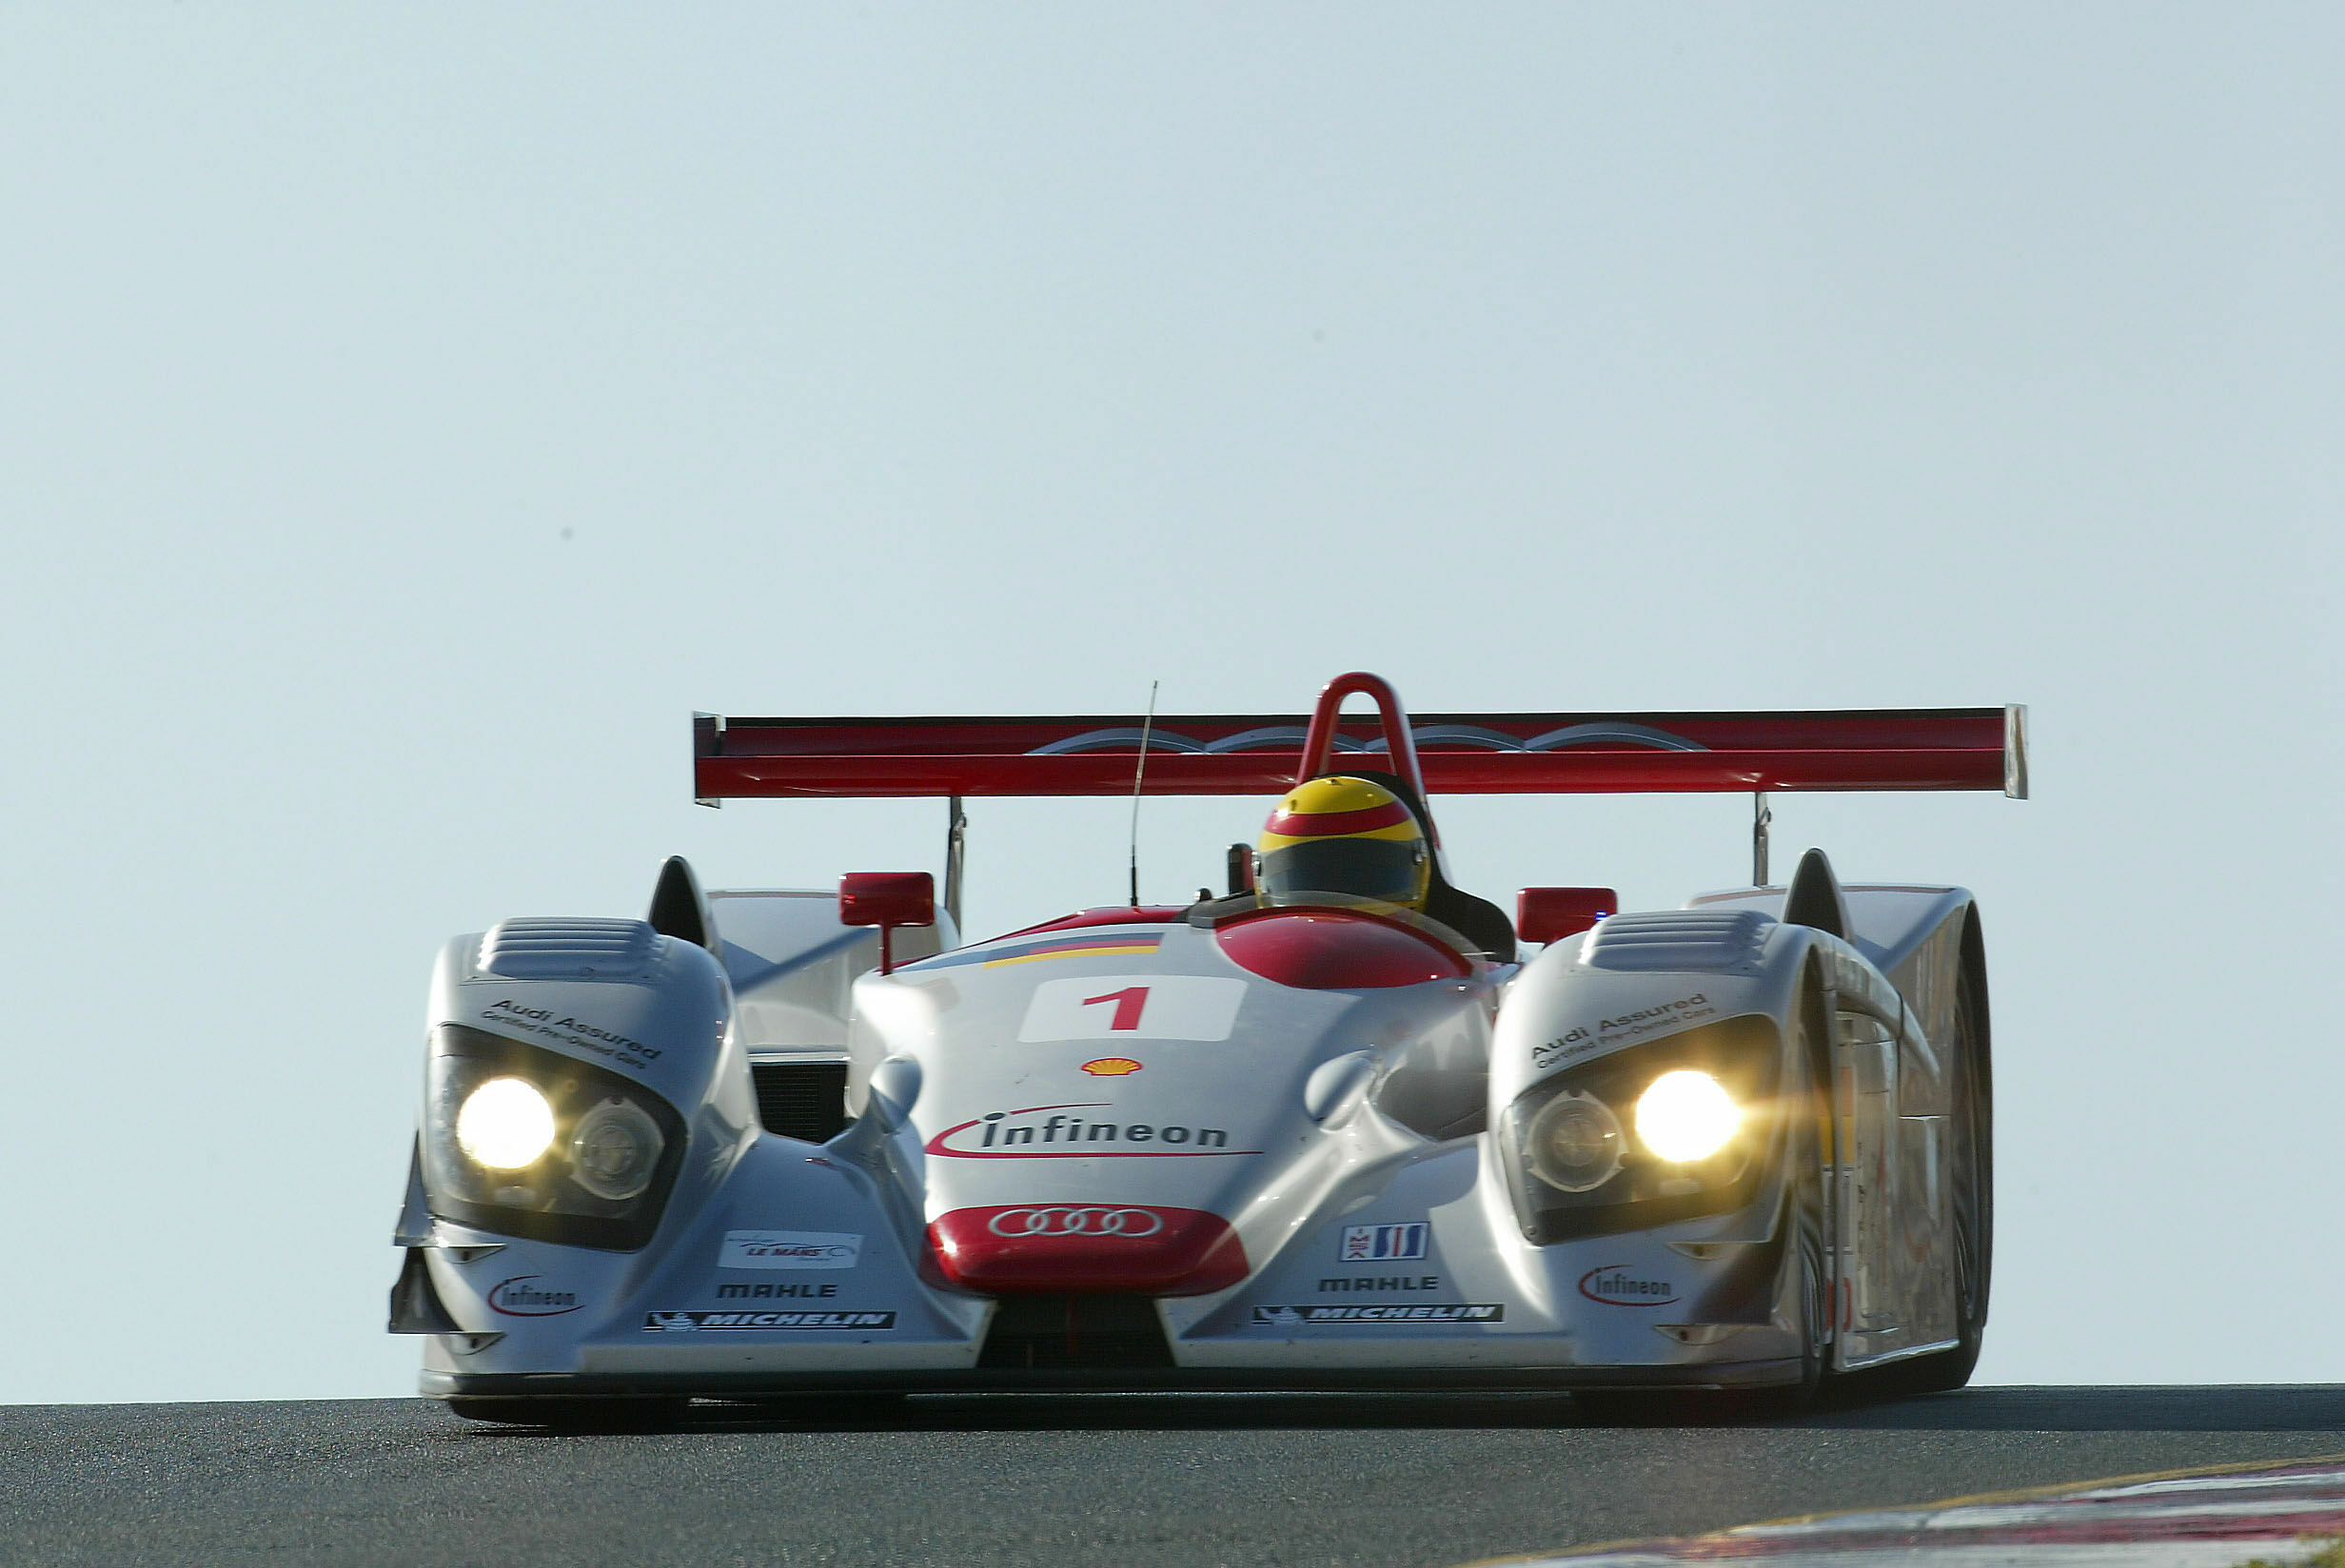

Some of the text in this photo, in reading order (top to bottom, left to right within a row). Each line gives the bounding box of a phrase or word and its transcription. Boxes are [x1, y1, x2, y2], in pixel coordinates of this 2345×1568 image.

[1082, 986, 1151, 1031] 1
[490, 1000, 662, 1059] Audi Assured
[1532, 993, 1708, 1060] Audi Assured
[1537, 1042, 1596, 1069] Certified
[1682, 1007, 1716, 1020] Cars
[746, 1248, 769, 1257] LE
[716, 1284, 838, 1299] MAHLE
[1318, 1276, 1440, 1292] MAHLE
[701, 1313, 890, 1325] MICHELIN
[1308, 1306, 1496, 1320] MICHELIN
